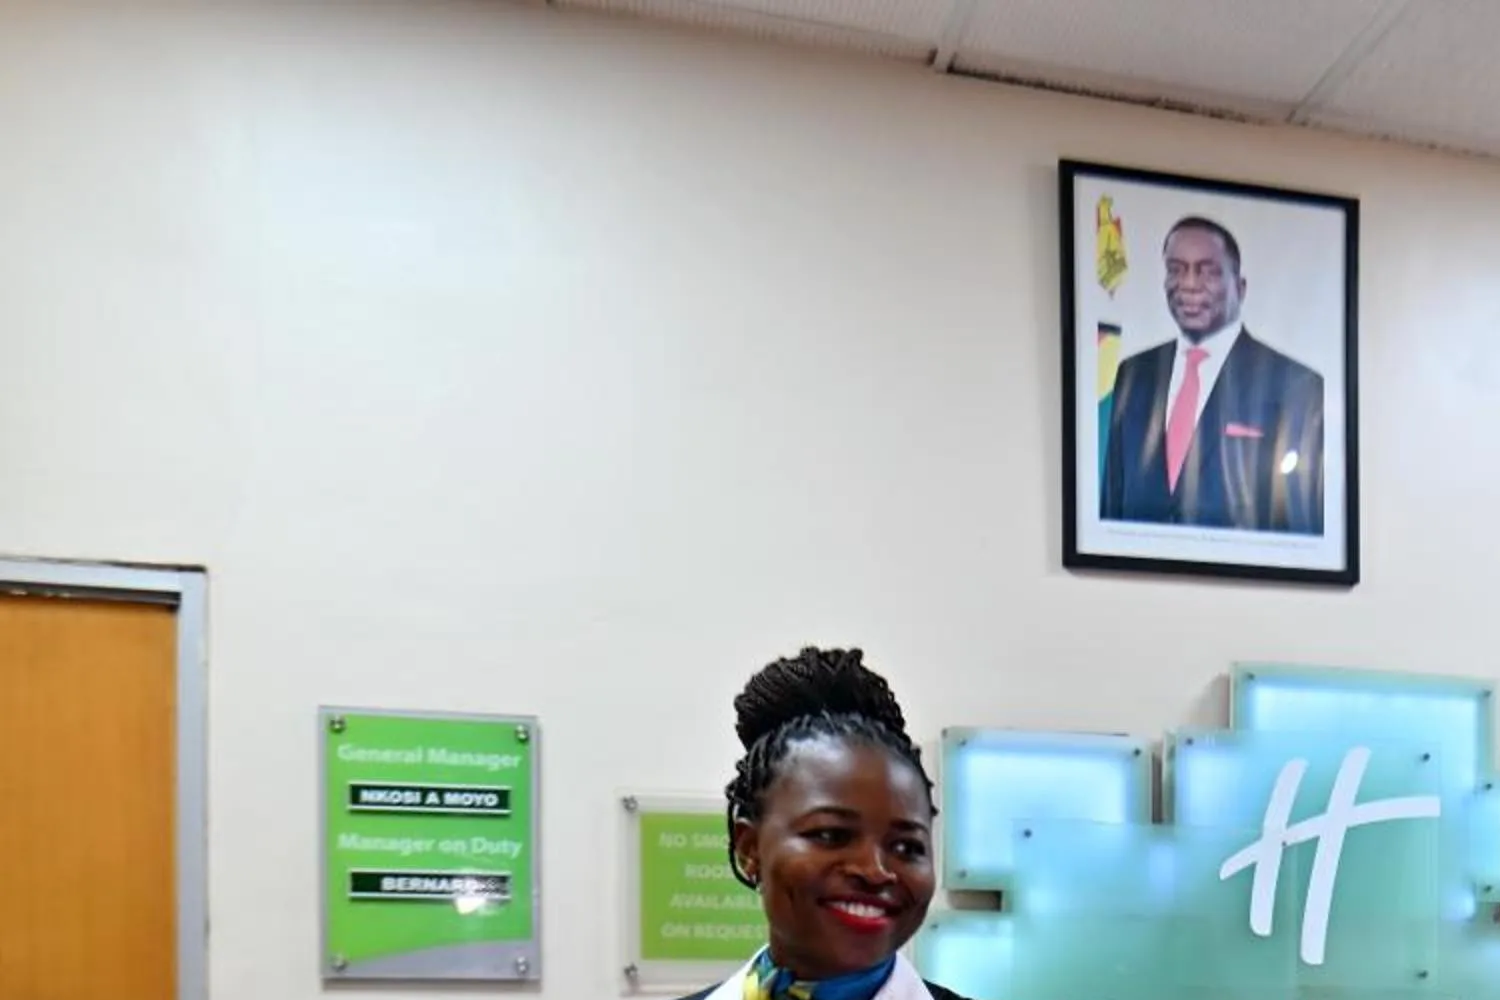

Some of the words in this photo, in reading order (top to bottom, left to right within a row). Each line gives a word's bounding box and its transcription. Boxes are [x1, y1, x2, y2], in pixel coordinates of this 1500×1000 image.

[337, 743, 423, 764] General
[427, 746, 522, 771] Manager
[360, 789, 421, 804] NKOSI
[425, 791, 440, 805] A
[444, 792, 500, 807] MOYO
[337, 832, 436, 856] Manager
[439, 839, 466, 855] on
[471, 836, 522, 859] Duty
[659, 832, 688, 848] NO
